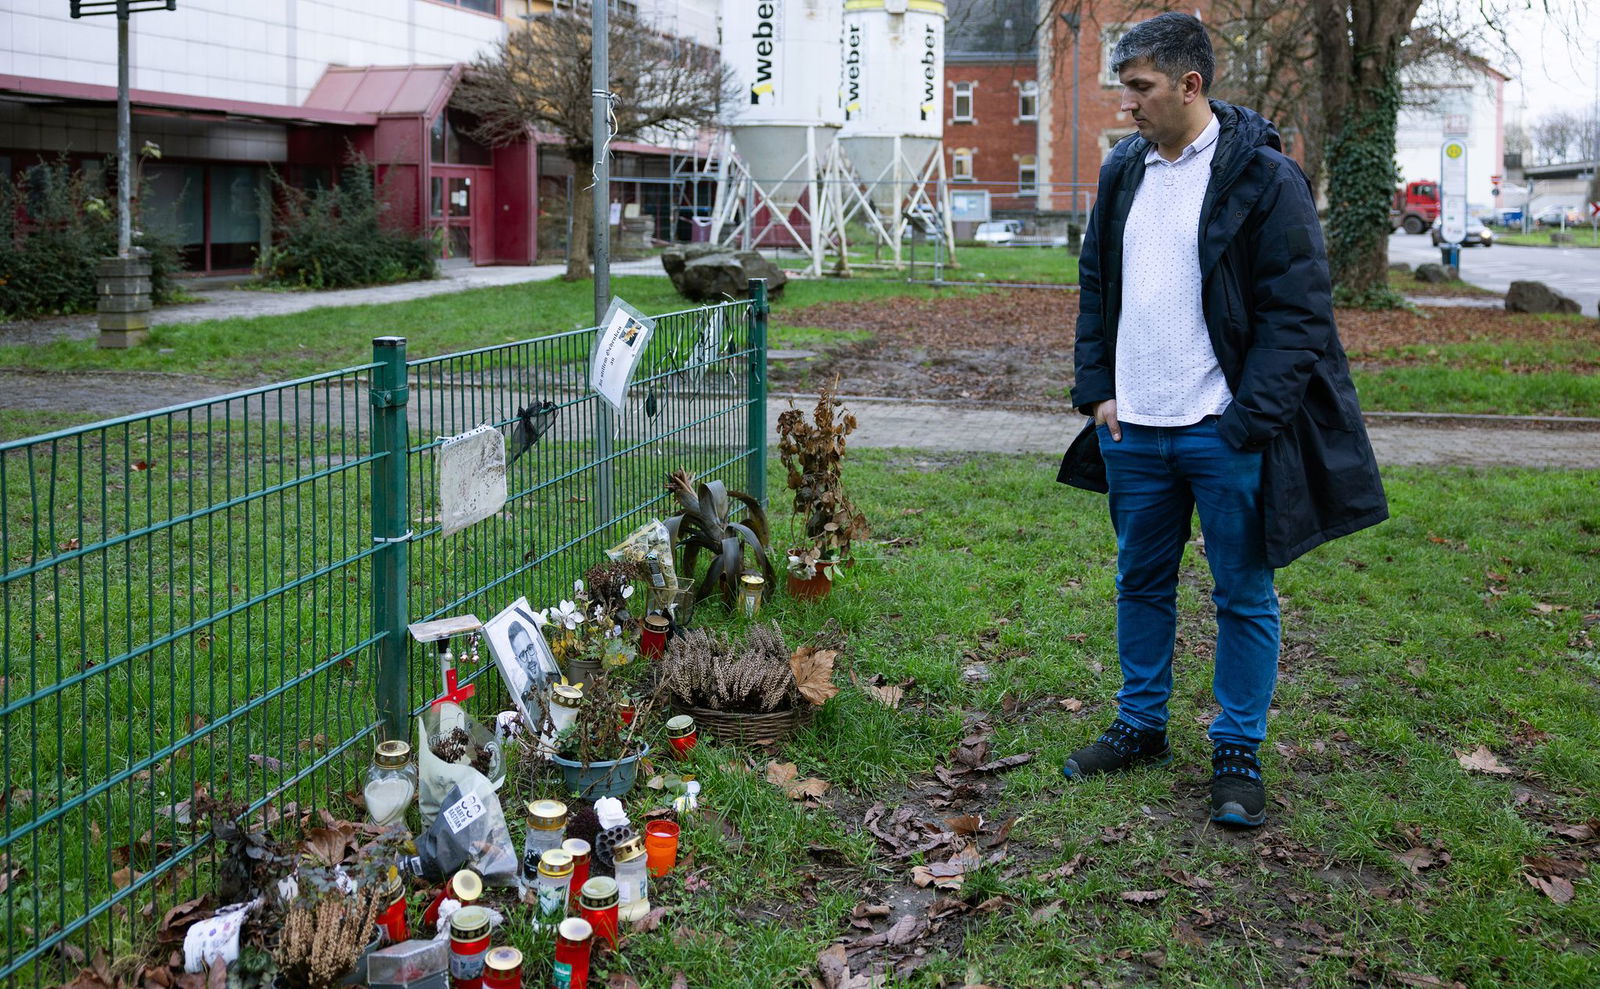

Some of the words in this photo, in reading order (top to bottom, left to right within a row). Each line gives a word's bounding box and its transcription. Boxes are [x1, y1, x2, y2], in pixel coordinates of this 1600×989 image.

[752, 0, 773, 83] webe
[847, 24, 860, 102] weber
[921, 24, 935, 102] weber
